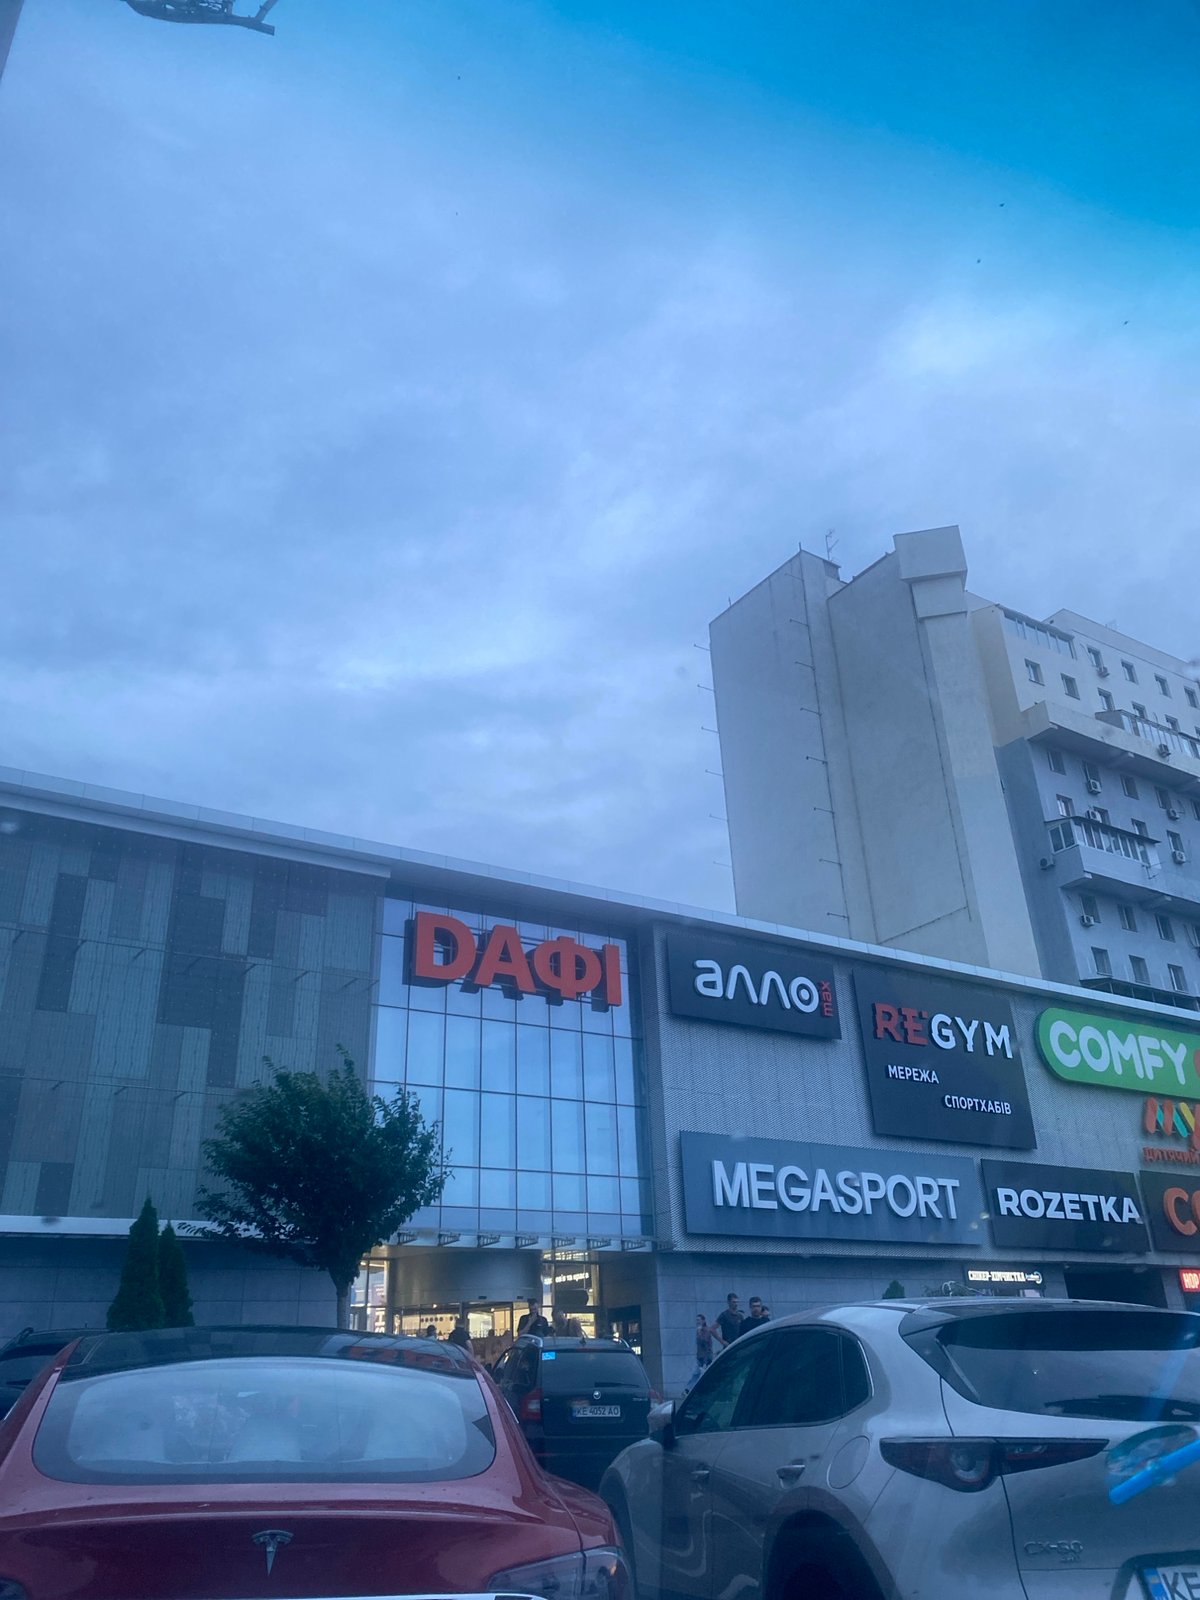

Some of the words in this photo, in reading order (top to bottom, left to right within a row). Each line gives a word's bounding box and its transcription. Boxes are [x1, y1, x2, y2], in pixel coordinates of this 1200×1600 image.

[1049, 1020, 1187, 1085] COMFY
[887, 1064, 940, 1084] МЕРЕЖА
[944, 1094, 1012, 1115] СПОРТХАБІВ
[712, 1160, 960, 1219] MEGASPORT
[996, 1187, 1143, 1224] ROZETKA
